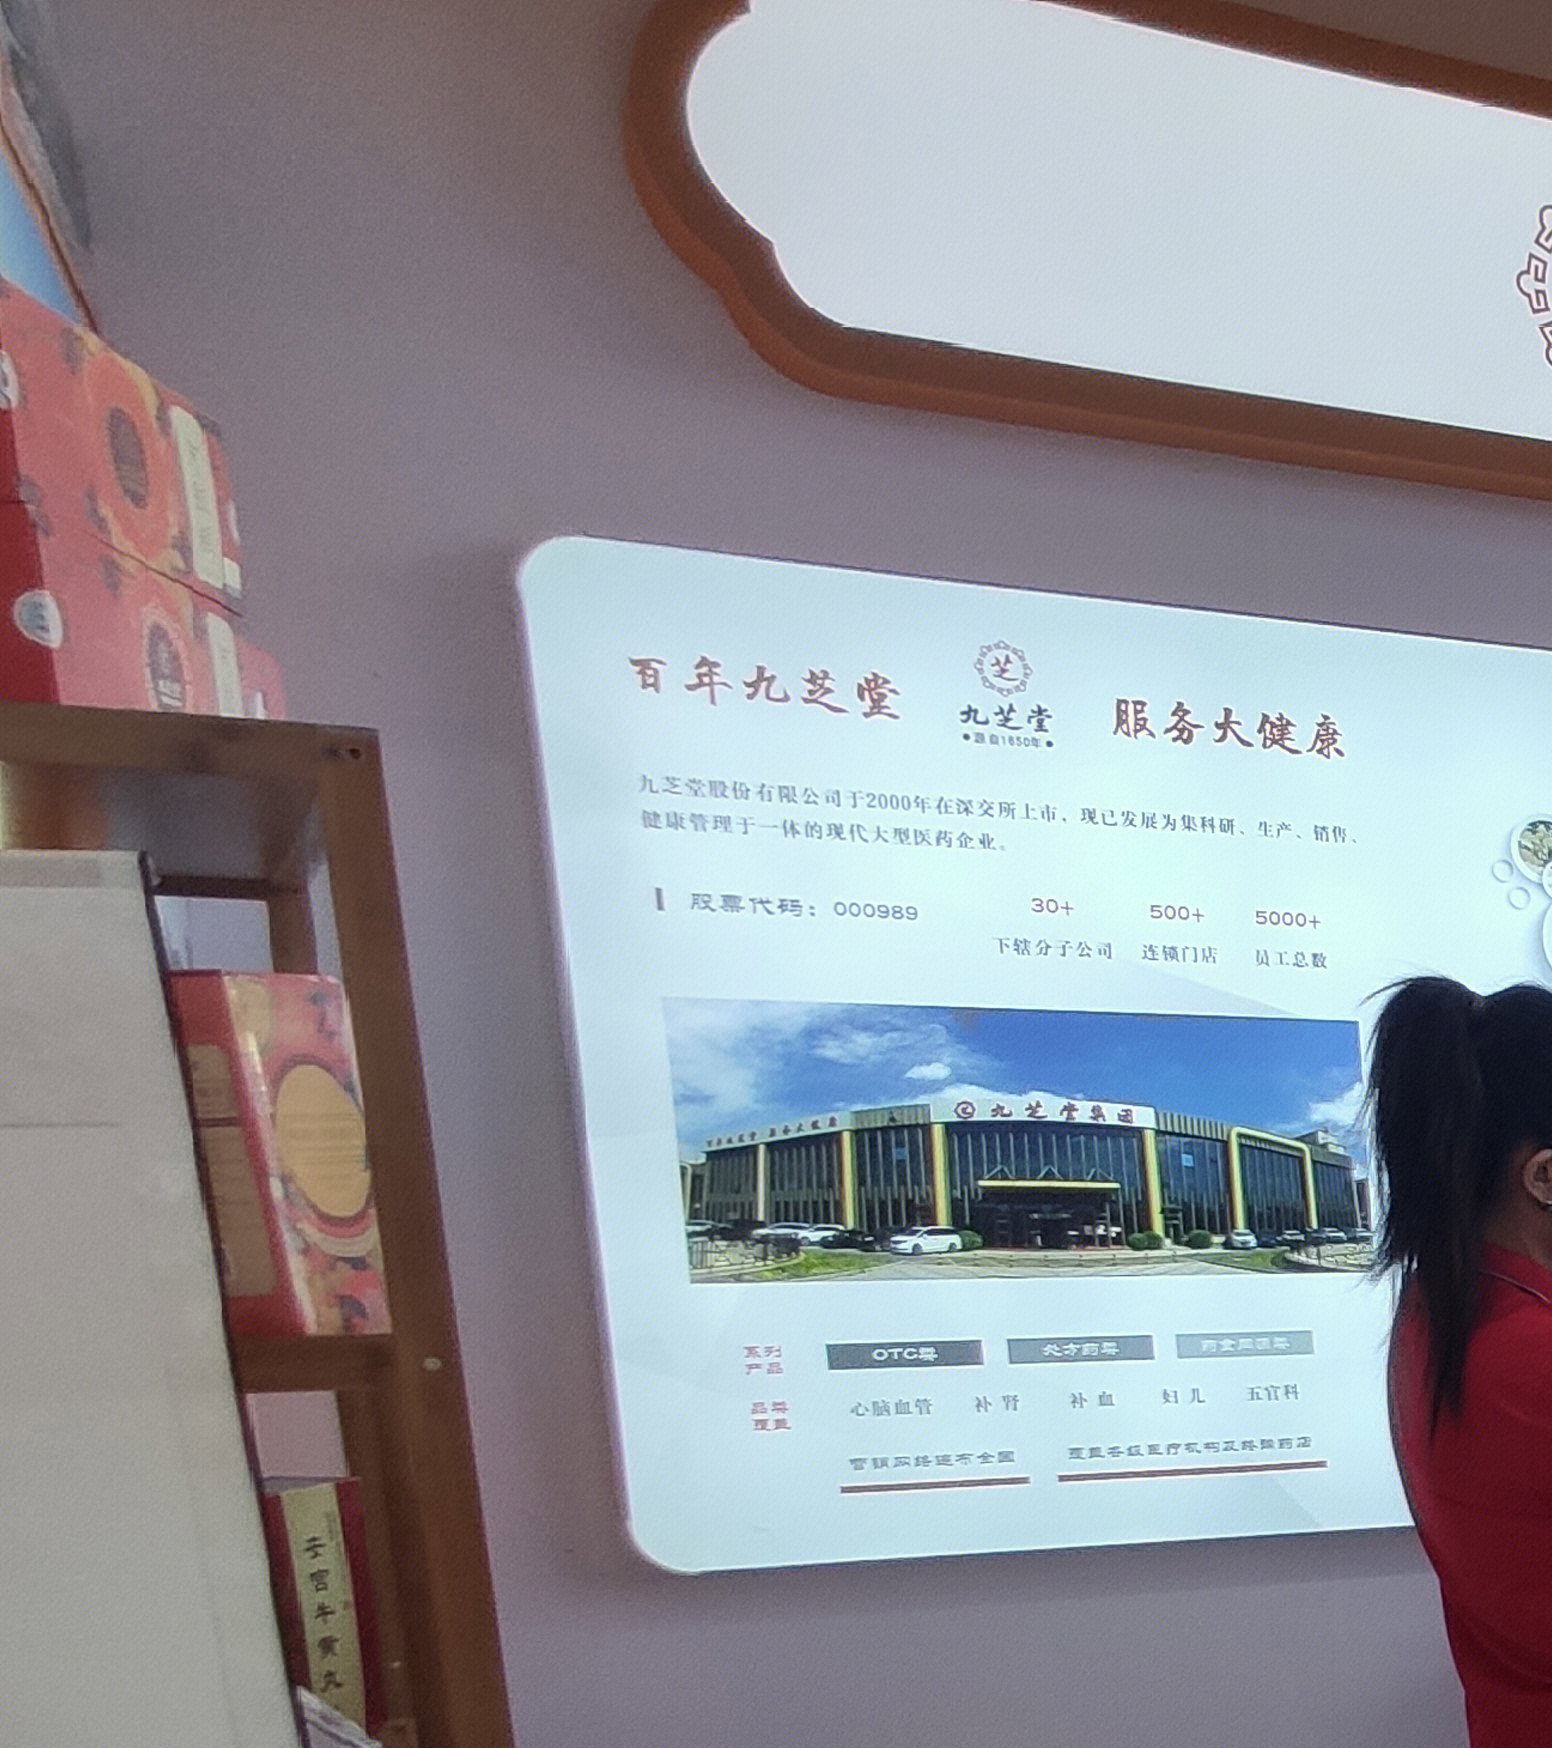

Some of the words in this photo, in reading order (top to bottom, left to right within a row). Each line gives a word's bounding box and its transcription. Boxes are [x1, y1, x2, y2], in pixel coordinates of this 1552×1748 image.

[990, 654, 1020, 682] 芝
[628, 655, 902, 721] 百年九芝堂
[959, 702, 1054, 734] 九芝堂
[1112, 697, 1345, 760] 服务大健康
[832, 901, 919, 921] 000989
[1030, 897, 1075, 916] 30+
[1149, 904, 1205, 923] 500+
[1254, 910, 1321, 929] 5000+
[993, 937, 1113, 960] 下辖分子公司
[1141, 943, 1219, 965] 连锁门店
[1254, 949, 1328, 969] 员工总数
[743, 1345, 783, 1359] 系列
[744, 1362, 785, 1375] 产品
[850, 1397, 933, 1417] 心脑血管
[1247, 1383, 1300, 1402] 五官科
